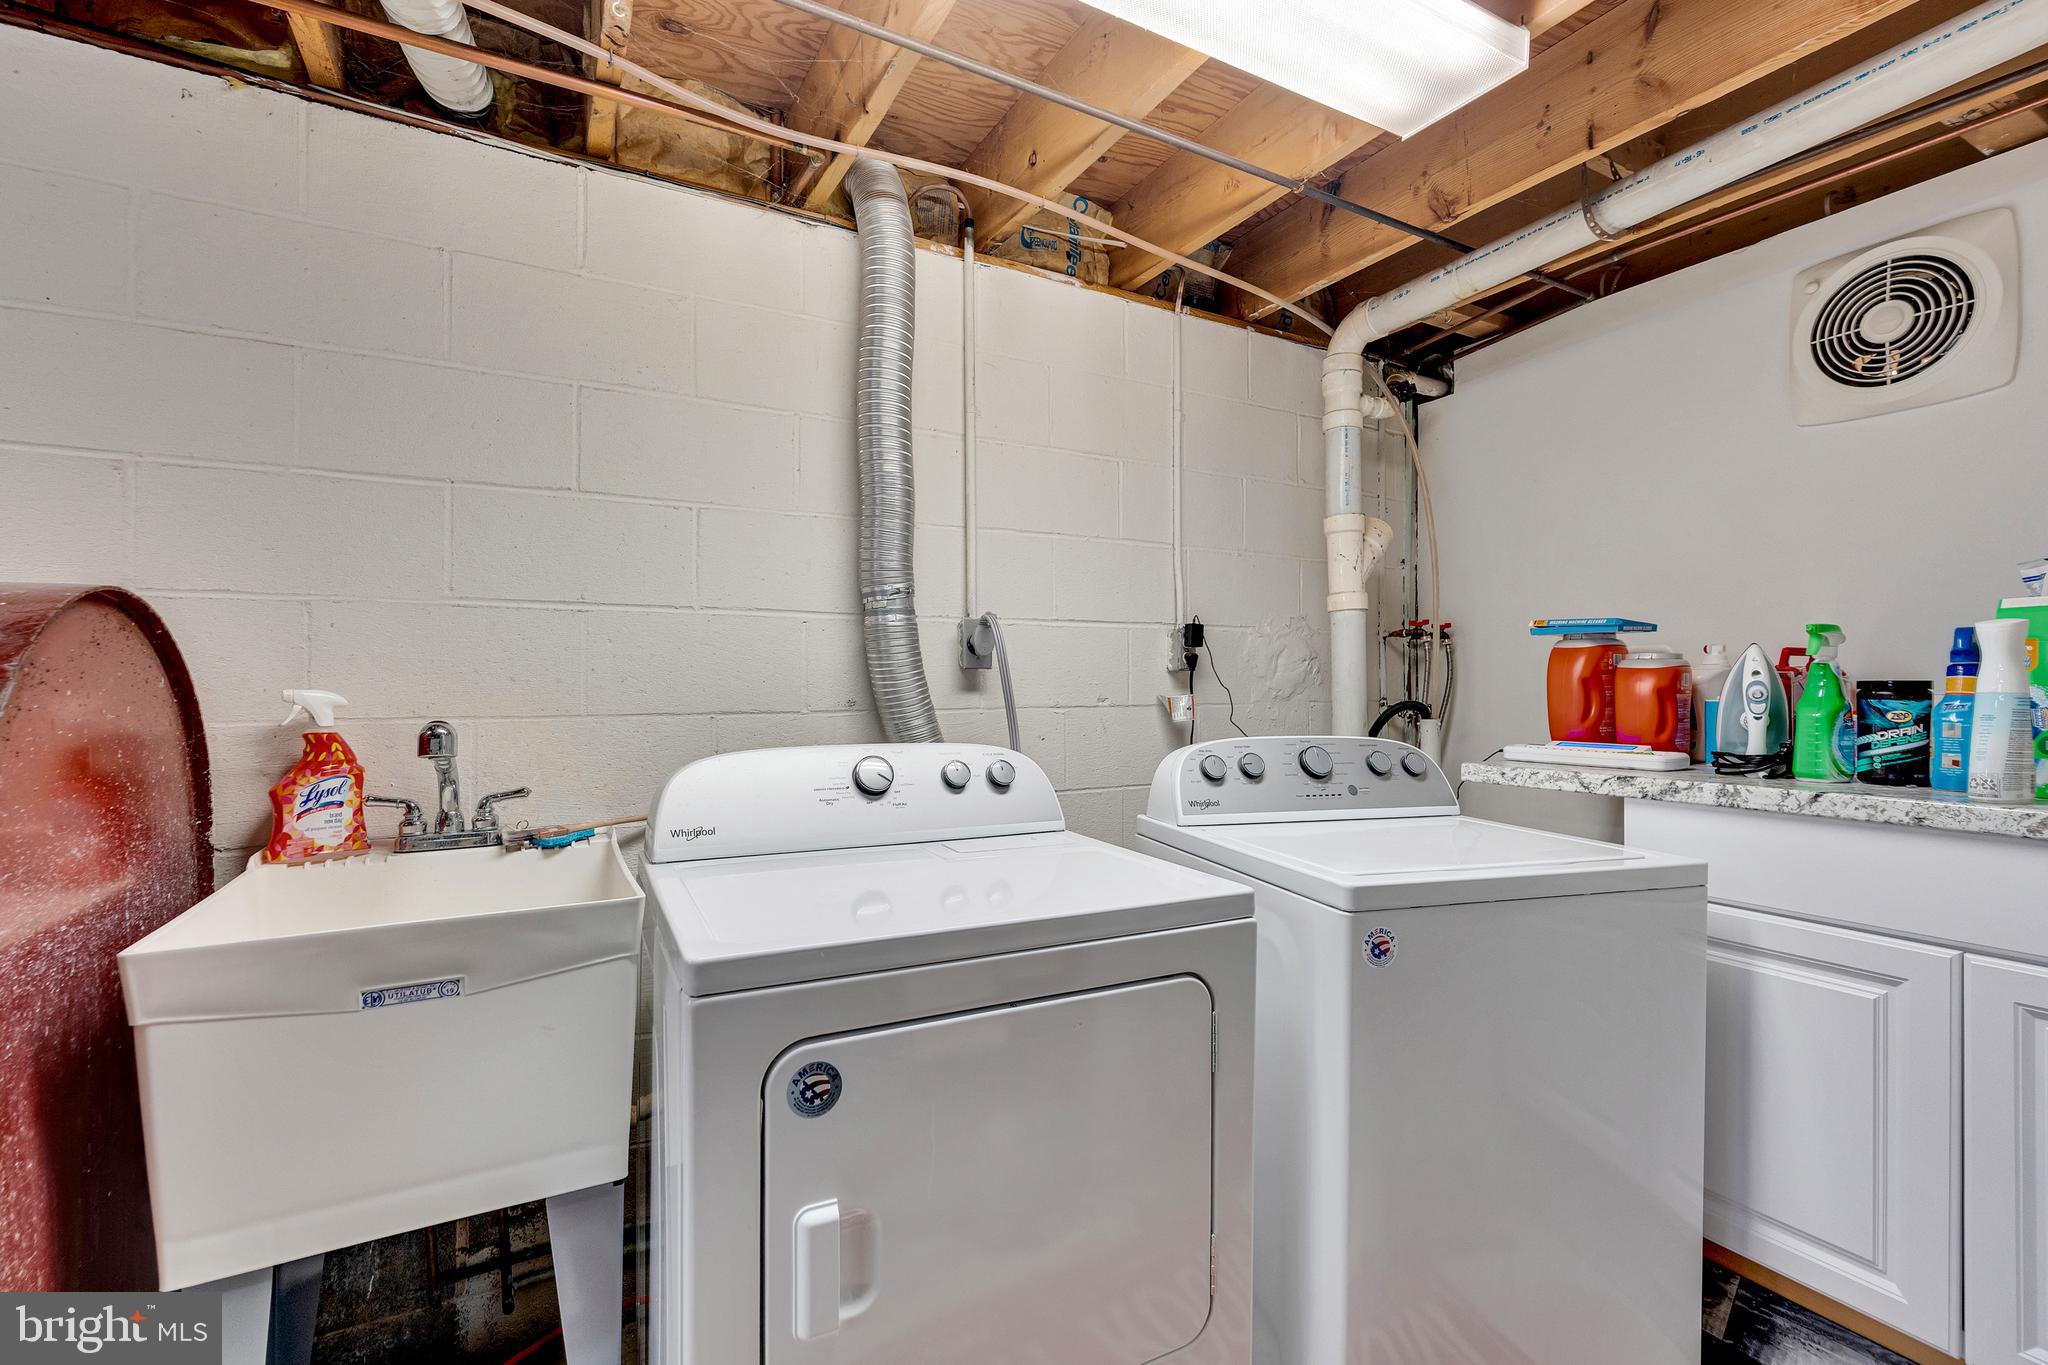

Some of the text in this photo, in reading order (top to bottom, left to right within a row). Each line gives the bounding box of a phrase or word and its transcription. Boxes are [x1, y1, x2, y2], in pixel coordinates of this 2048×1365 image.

[1870, 730, 1929, 750] DEFENSE
[1876, 723, 1924, 740] DRAIN
[299, 779, 348, 808] Lysol
[1188, 798, 1221, 811] Whirlpool
[669, 826, 716, 842] Whirlpool
[1364, 927, 1395, 946] AMERICA
[792, 1063, 839, 1088] AMERICA
